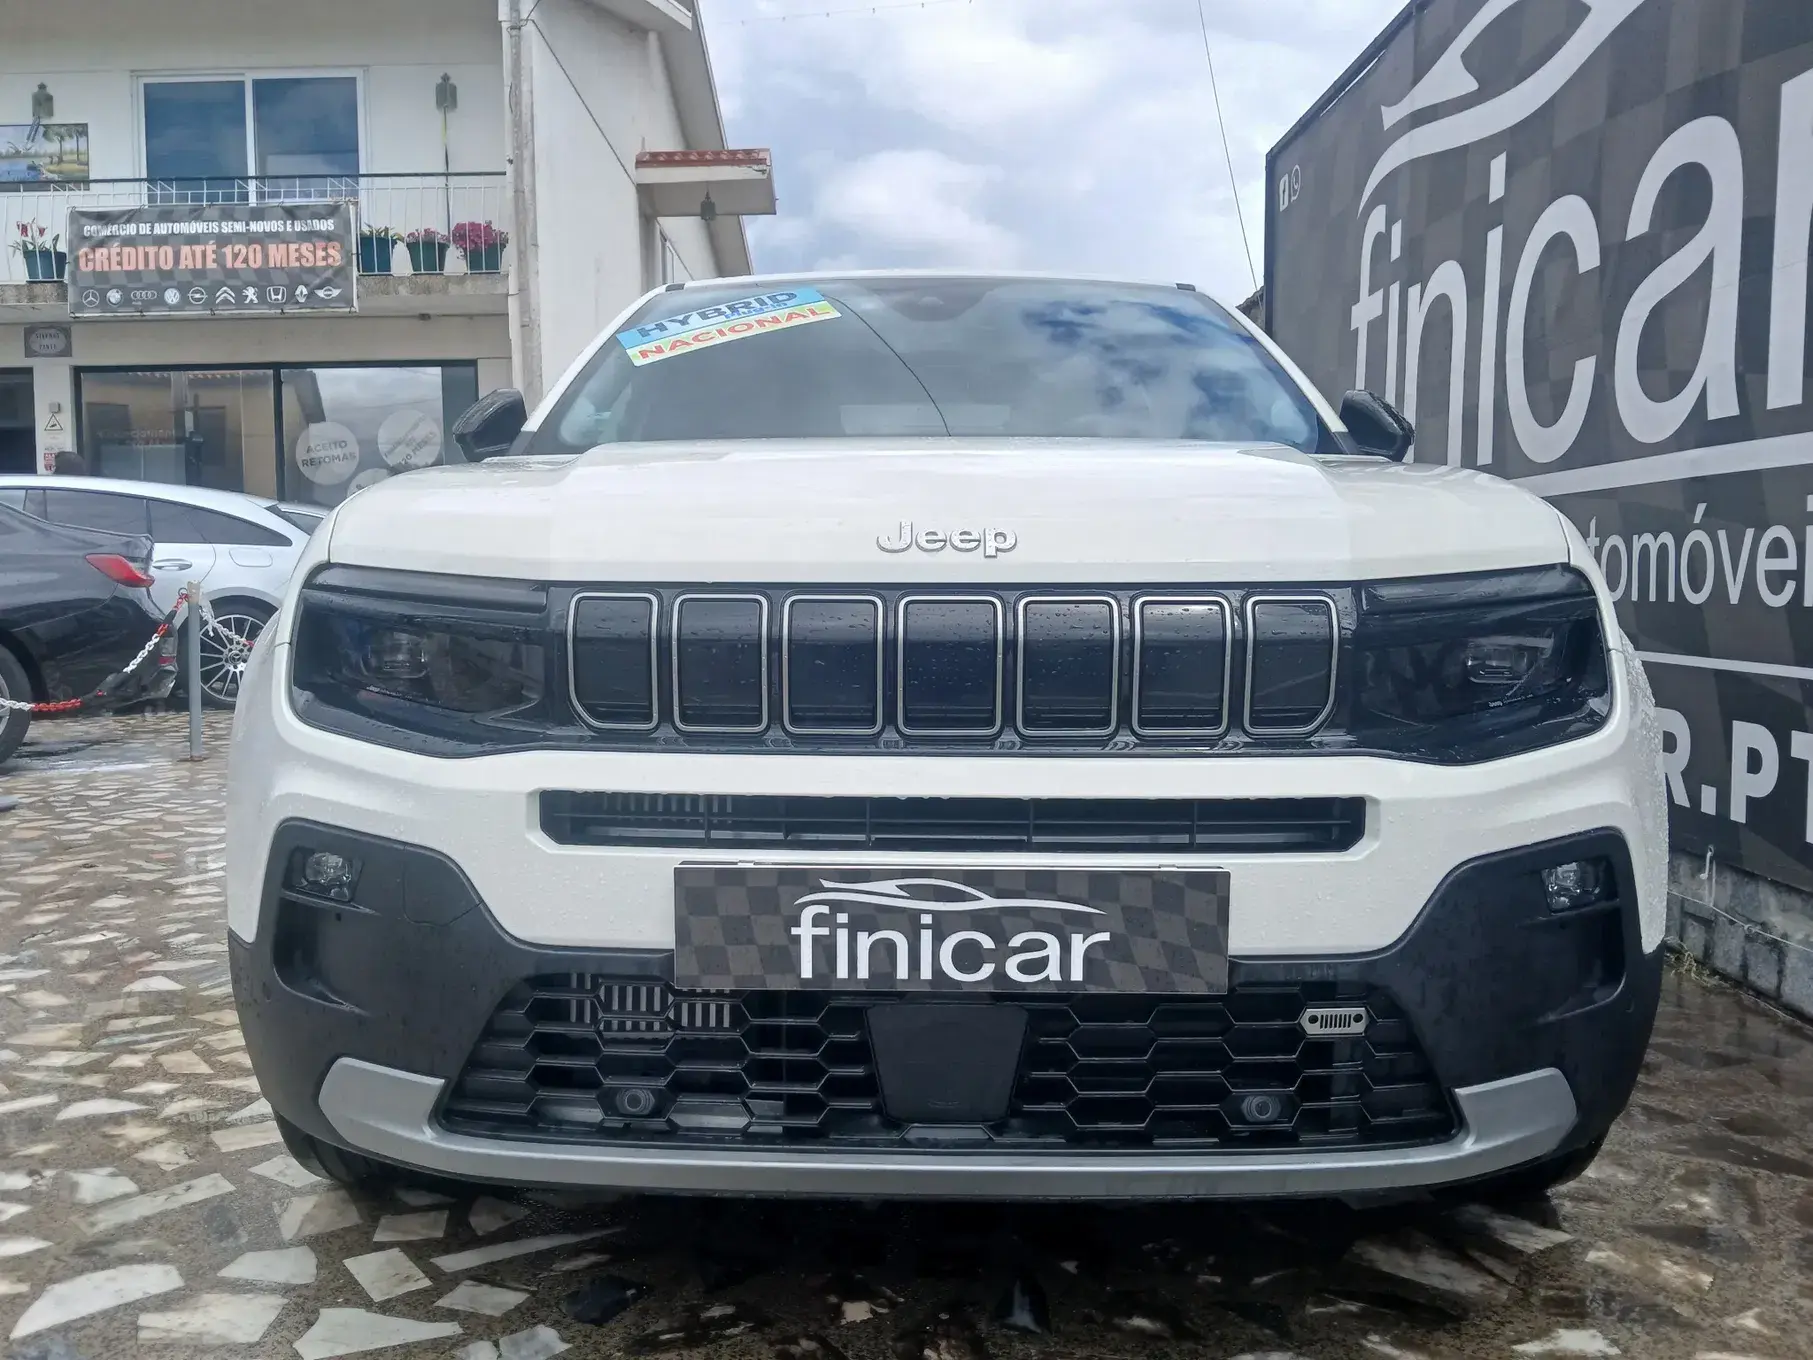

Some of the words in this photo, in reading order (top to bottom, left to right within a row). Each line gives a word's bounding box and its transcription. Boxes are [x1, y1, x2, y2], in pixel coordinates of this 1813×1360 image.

[83, 222, 137, 237] COMÉRCIO
[139, 223, 152, 235] DE
[153, 220, 219, 235] AUTOMÓVEIS
[221, 220, 284, 234] SEMI-NOVOS
[286, 220, 292, 232] E
[294, 218, 335, 232] USADOS
[78, 242, 174, 272] CRÉDITO
[178, 240, 218, 270] ATÉ
[221, 243, 262, 269] 120
[267, 241, 342, 269] MESES
[636, 292, 798, 338] HYBRID
[637, 307, 831, 360] NACIONAL
[301, 451, 357, 467] RETOMAS
[306, 440, 348, 454] ACEITO
[876, 520, 1017, 558] Jeep
[790, 904, 1111, 982] finicar
